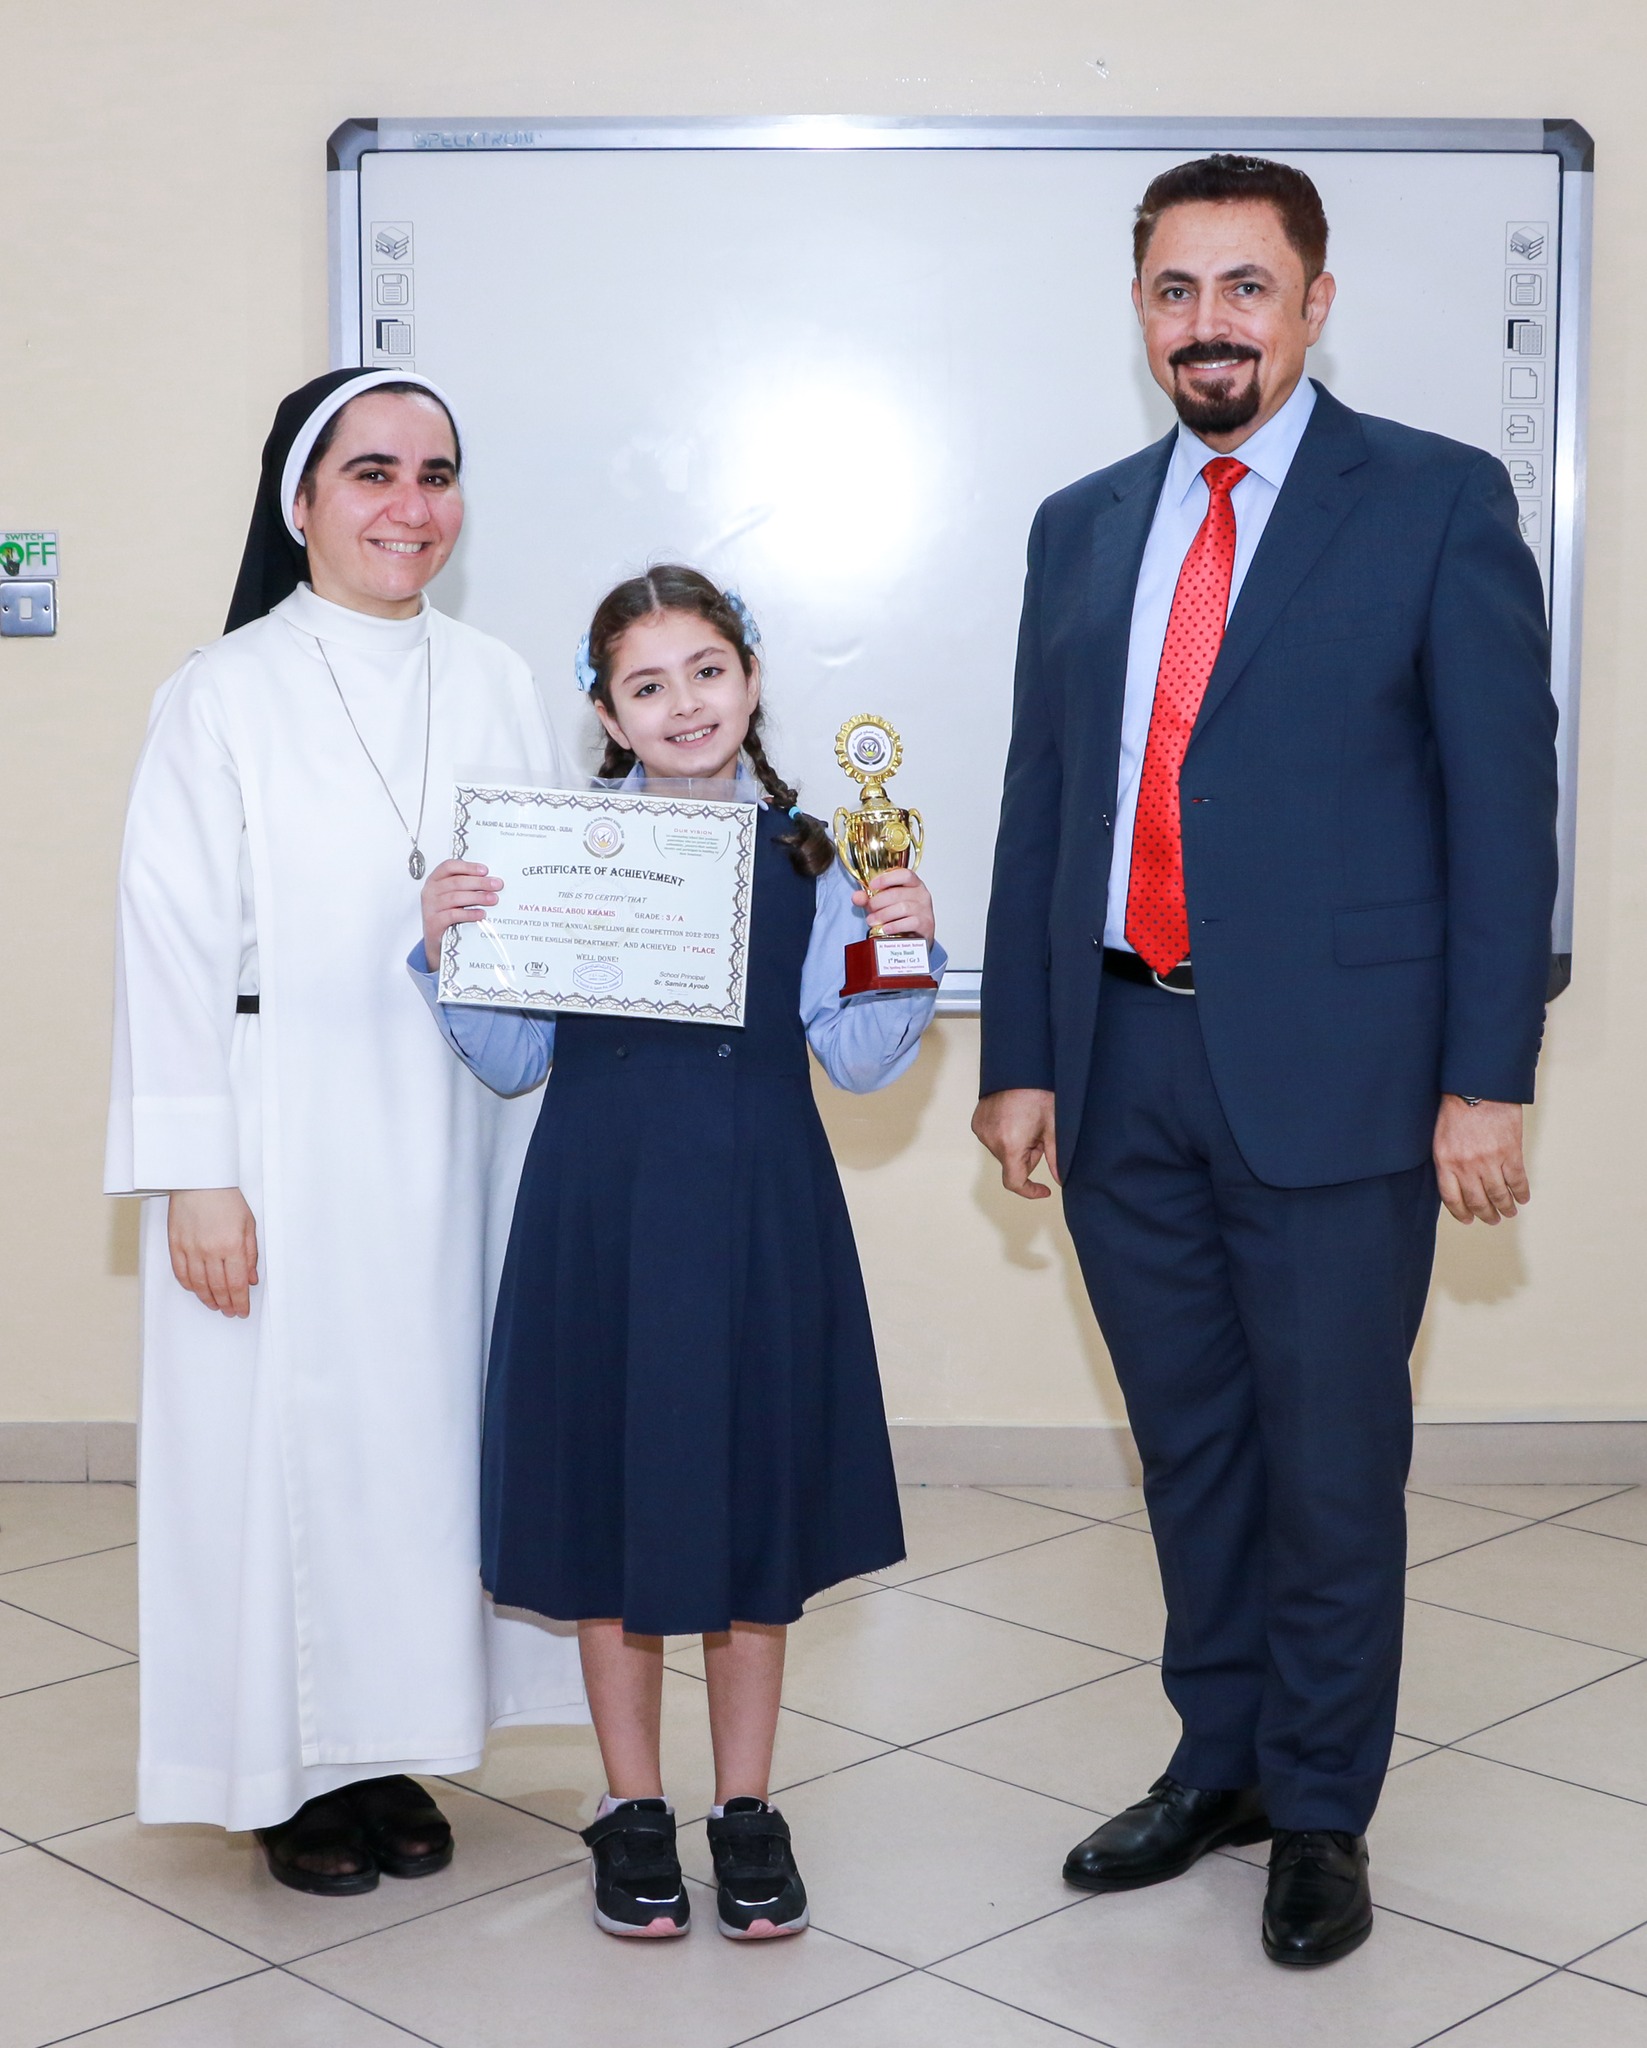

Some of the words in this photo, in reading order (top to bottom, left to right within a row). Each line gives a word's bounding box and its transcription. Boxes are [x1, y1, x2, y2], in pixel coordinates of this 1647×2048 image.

[5, 533, 44, 541] SWITCH
[521, 864, 592, 877] CERTIFICATE
[594, 866, 608, 876] OF
[610, 867, 685, 887] ACHIEVEMENT
[557, 891, 574, 899] THIS
[594, 894, 627, 902] CERTIFY
[627, 896, 648, 904] THAT
[518, 904, 540, 912] NAYA
[541, 906, 564, 914] BASIL
[565, 907, 586, 915] ABOU
[587, 908, 616, 917] KHAMIS
[493, 918, 541, 927] PARTICIPATED
[565, 922, 592, 930] ANNUAL
[593, 924, 625, 933] SPELLING
[626, 926, 640, 934] BEE
[640, 927, 684, 936] COMPETITION
[685, 931, 720, 940] 2022-2023
[623, 941, 639, 949] AND
[640, 942, 677, 951] ACHIEVED
[692, 946, 716, 955] PLACE
[576, 953, 596, 961] WELL
[469, 962, 495, 970] MARCH
[659, 971, 680, 979] School
[680, 973, 706, 981] Principal
[664, 980, 688, 988] Samira
[688, 982, 710, 990] Ayoub
